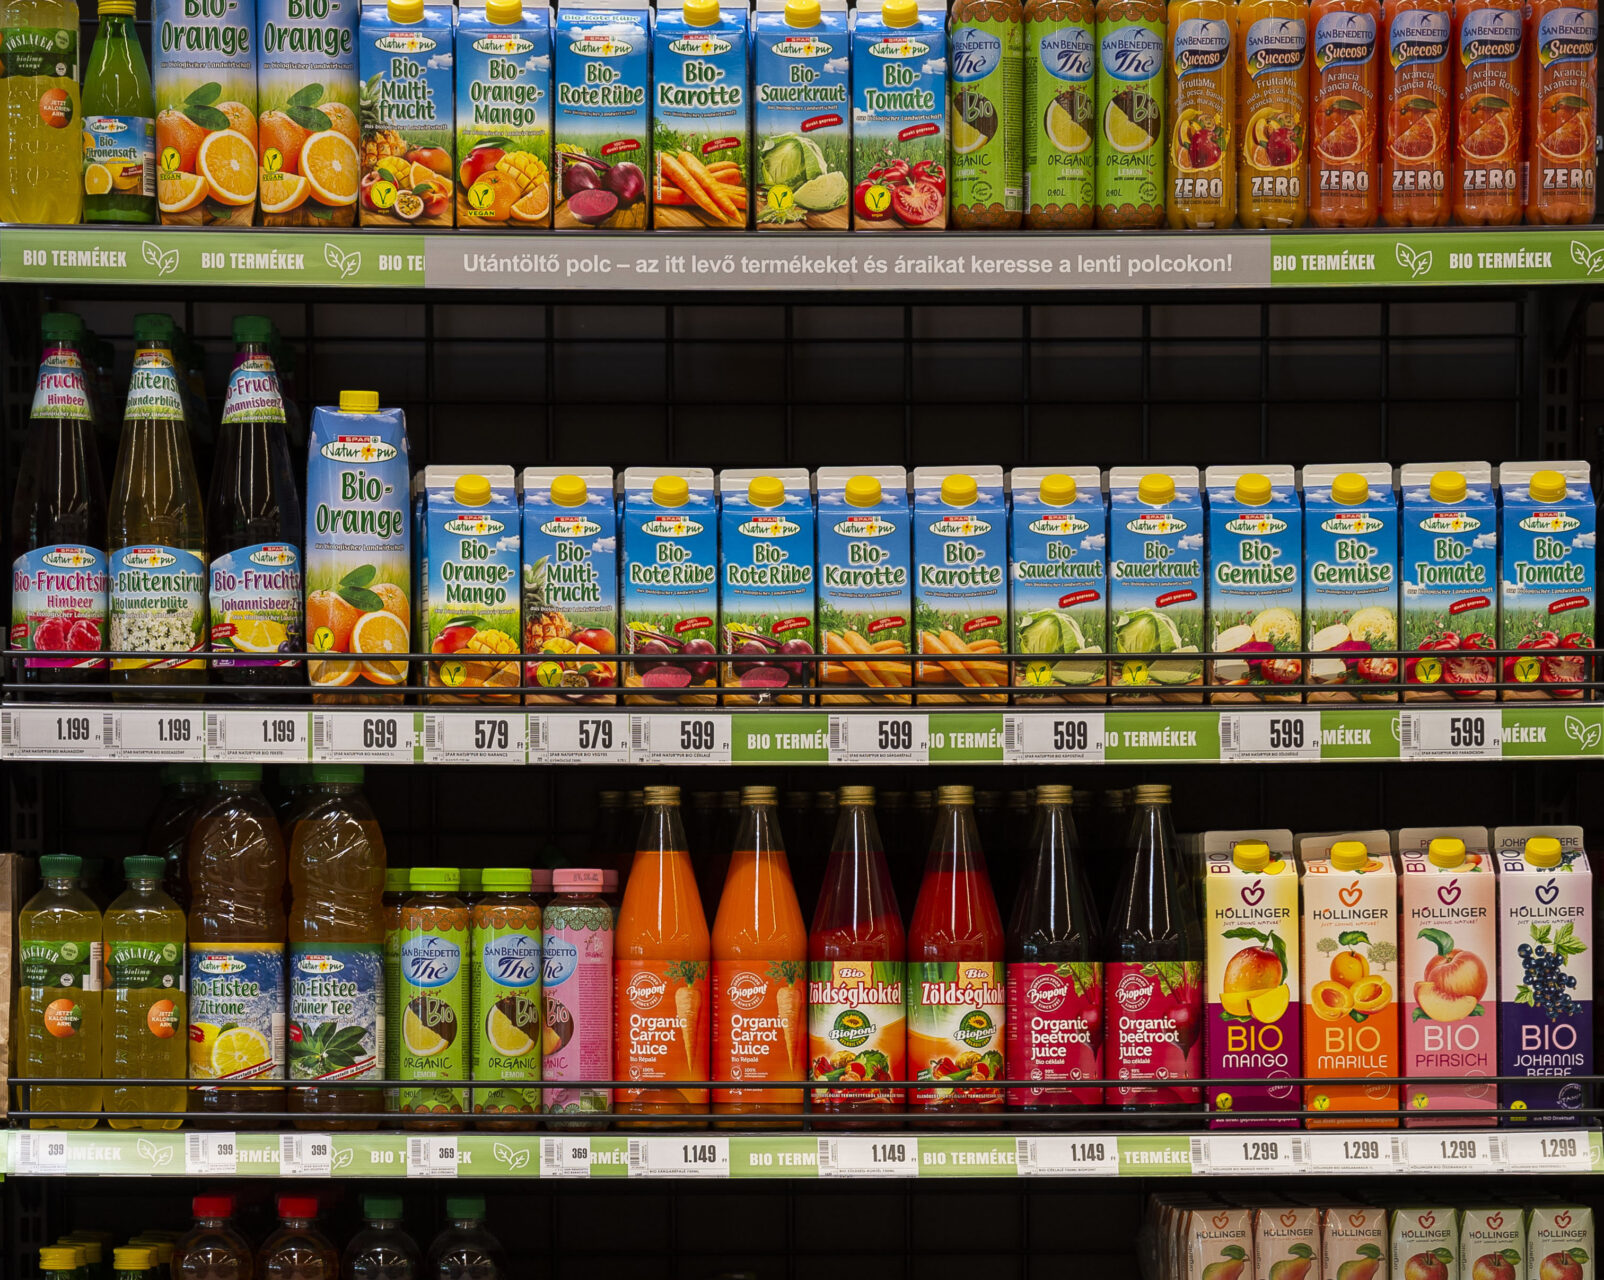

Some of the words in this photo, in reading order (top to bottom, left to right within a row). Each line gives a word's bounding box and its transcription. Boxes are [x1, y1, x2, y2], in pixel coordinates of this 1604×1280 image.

[162, 23, 249, 57] Orange
[1400, 42, 1442, 58] Succoso
[392, 59, 426, 80] Bio-
[584, 63, 619, 83] Bio-
[885, 65, 921, 86] Bio-
[381, 83, 433, 102] Multi-
[469, 83, 544, 104] Orange-
[560, 85, 600, 105] Rote
[602, 85, 644, 105] Rübe
[659, 86, 741, 105] Karotte
[761, 84, 846, 101] Sauerkraut
[867, 89, 934, 110] Tomate
[379, 101, 434, 121] frucht
[474, 104, 535, 126] Mango
[1106, 154, 1157, 167] ORGANIC
[1174, 178, 1223, 198] ZERO
[1463, 170, 1516, 190] ZERO
[463, 252, 560, 273] Utántöltő
[566, 253, 611, 277] polc
[636, 258, 660, 274] az
[664, 255, 686, 274] itt
[691, 254, 735, 274] levő
[741, 254, 858, 274] termékeket
[863, 254, 888, 274] és
[894, 253, 965, 274] áraikat
[971, 255, 1053, 274] keresse
[1059, 259, 1071, 274] a
[1078, 254, 1122, 274] lenti
[1128, 253, 1233, 278] polcokon!
[1273, 255, 1296, 271] BIO
[1301, 249, 1375, 271] TERMÉKEK
[325, 442, 358, 458] Natur
[377, 444, 397, 459] pur
[341, 472, 393, 500] Bio-
[316, 503, 403, 537] Orange
[1217, 563, 1295, 584] Gemüse
[47, 595, 93, 608] Himbeer
[57, 719, 89, 741] 1.199
[262, 720, 295, 742] 1.199
[363, 719, 397, 747] 699
[474, 720, 508, 749] 579
[680, 720, 714, 750] 599
[1053, 721, 1088, 750] 599
[1123, 727, 1196, 748] TERMÉKEK
[199, 1001, 245, 1017] Zitrone
[293, 1000, 330, 1017] Grüner
[331, 1000, 353, 1015] Tee
[630, 1016, 687, 1032] Organic
[1031, 1017, 1088, 1034] Organic
[630, 1029, 675, 1042] Carrot
[1031, 1031, 1090, 1044] beetroot
[1228, 1026, 1283, 1052] BIO
[1522, 1024, 1576, 1050] BIO
[630, 1042, 667, 1057] Juice
[1031, 1043, 1066, 1060] juice
[1223, 1053, 1288, 1068] MANGO
[1318, 1054, 1387, 1069] MARILLE
[1416, 1053, 1487, 1067] PFIRSICH
[1513, 1053, 1584, 1067] JOHANNIS
[217, 1144, 233, 1156] 399
[682, 1145, 716, 1163] 1.149
[872, 1144, 905, 1163] 1.149
[1243, 1142, 1278, 1160] 1.299
[1541, 1139, 1576, 1157] 1.299
